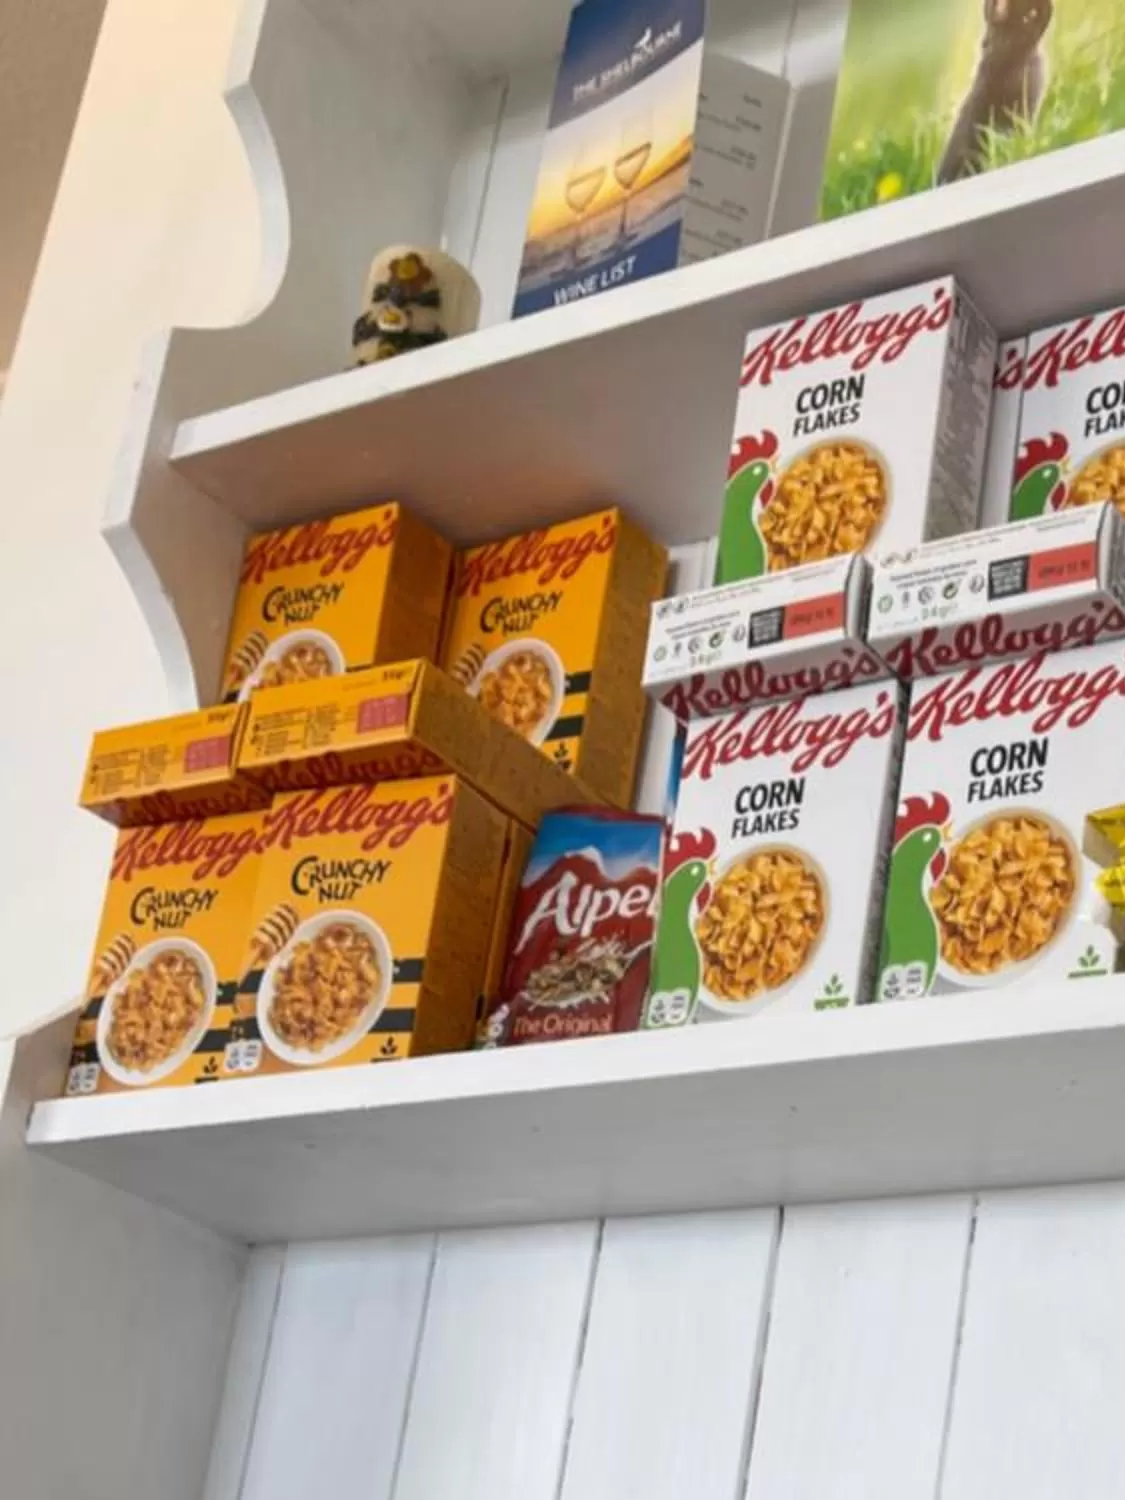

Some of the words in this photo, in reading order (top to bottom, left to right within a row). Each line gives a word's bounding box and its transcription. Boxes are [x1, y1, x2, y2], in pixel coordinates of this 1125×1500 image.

[553, 274, 600, 305] WINE
[601, 255, 637, 288] LIST
[738, 286, 952, 387] Kellogg's
[796, 373, 865, 414] CORN
[792, 402, 861, 437] FLAKES
[240, 510, 397, 585] Kellogg's
[458, 516, 617, 597] Kellogg's
[660, 646, 882, 722] Kellogg's
[680, 691, 897, 780] Kellogg's
[969, 737, 1050, 778] CORN
[734, 777, 806, 814] CORN
[967, 770, 1045, 803] FLAKES
[263, 783, 455, 851] Kellogg's
[731, 807, 801, 839] FLAKES
[110, 818, 264, 881] Kellogg
[290, 855, 392, 897] CRUNCHY
[318, 882, 363, 904] NUT
[130, 886, 219, 927] CRUNCHY
[152, 910, 191, 932] NUT
[513, 1014, 542, 1037] The
[543, 1013, 613, 1035] Original
